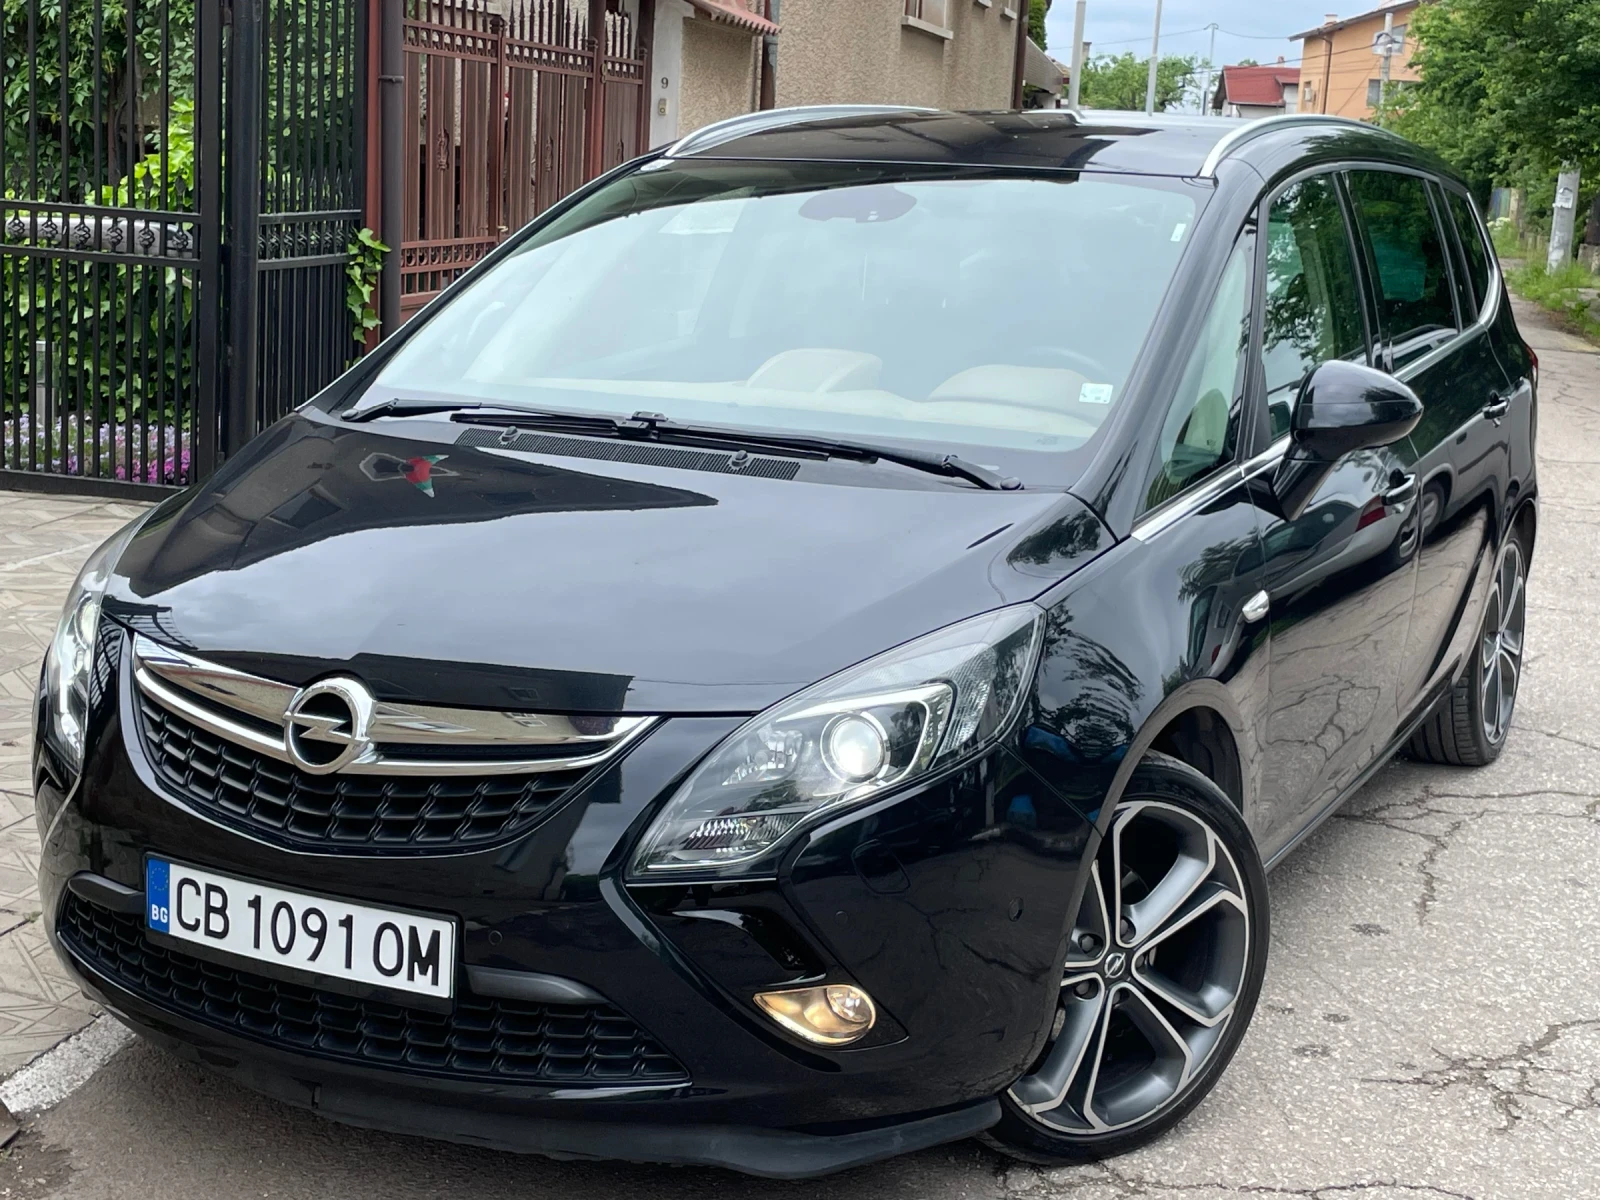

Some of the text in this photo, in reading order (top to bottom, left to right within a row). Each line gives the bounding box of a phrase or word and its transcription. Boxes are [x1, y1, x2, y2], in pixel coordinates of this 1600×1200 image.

[661, 76, 669, 89] 9
[151, 903, 168, 923] BG
[176, 877, 441, 987] CB 1091 OM
